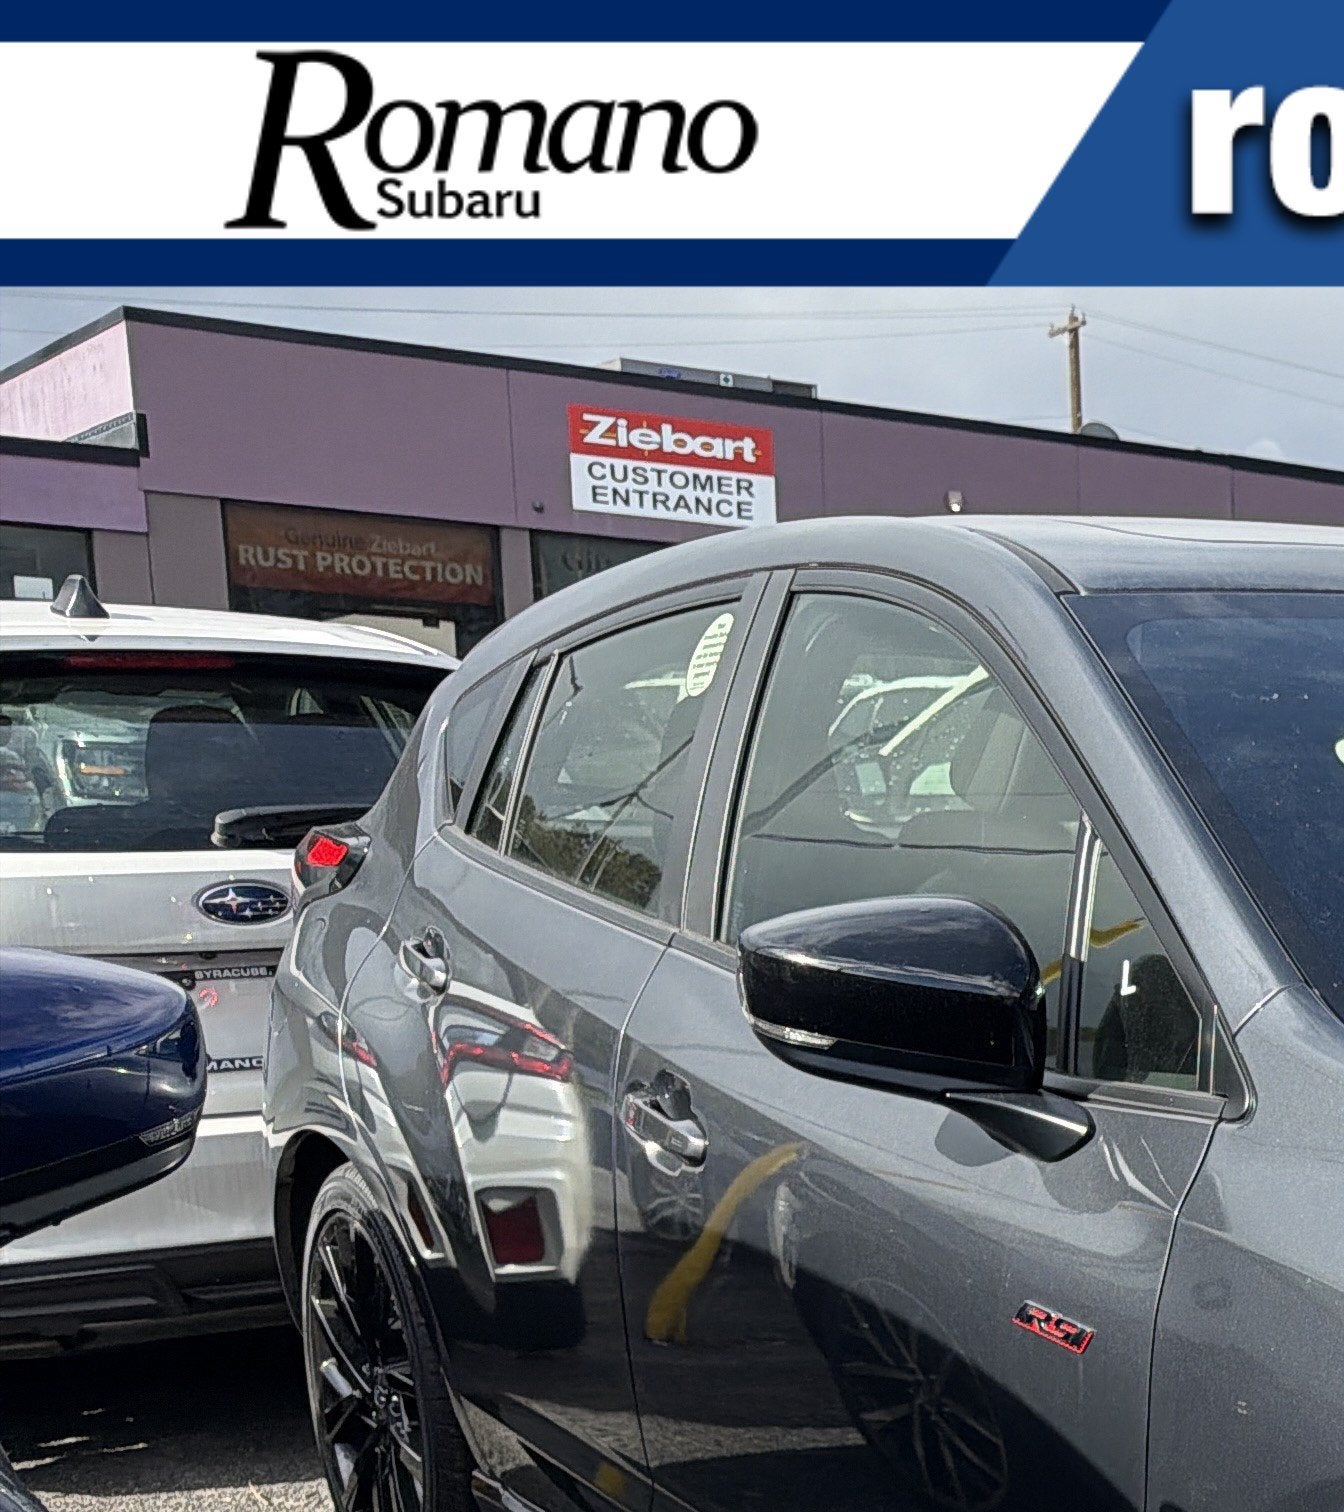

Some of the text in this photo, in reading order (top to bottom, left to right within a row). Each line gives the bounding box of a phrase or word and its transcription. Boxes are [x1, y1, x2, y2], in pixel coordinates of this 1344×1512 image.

[581, 412, 757, 464] Ziebart
[586, 461, 755, 498] CUSTOMER
[591, 485, 754, 521] ENTRANCE
[236, 544, 485, 587] RUST PROTECTION
